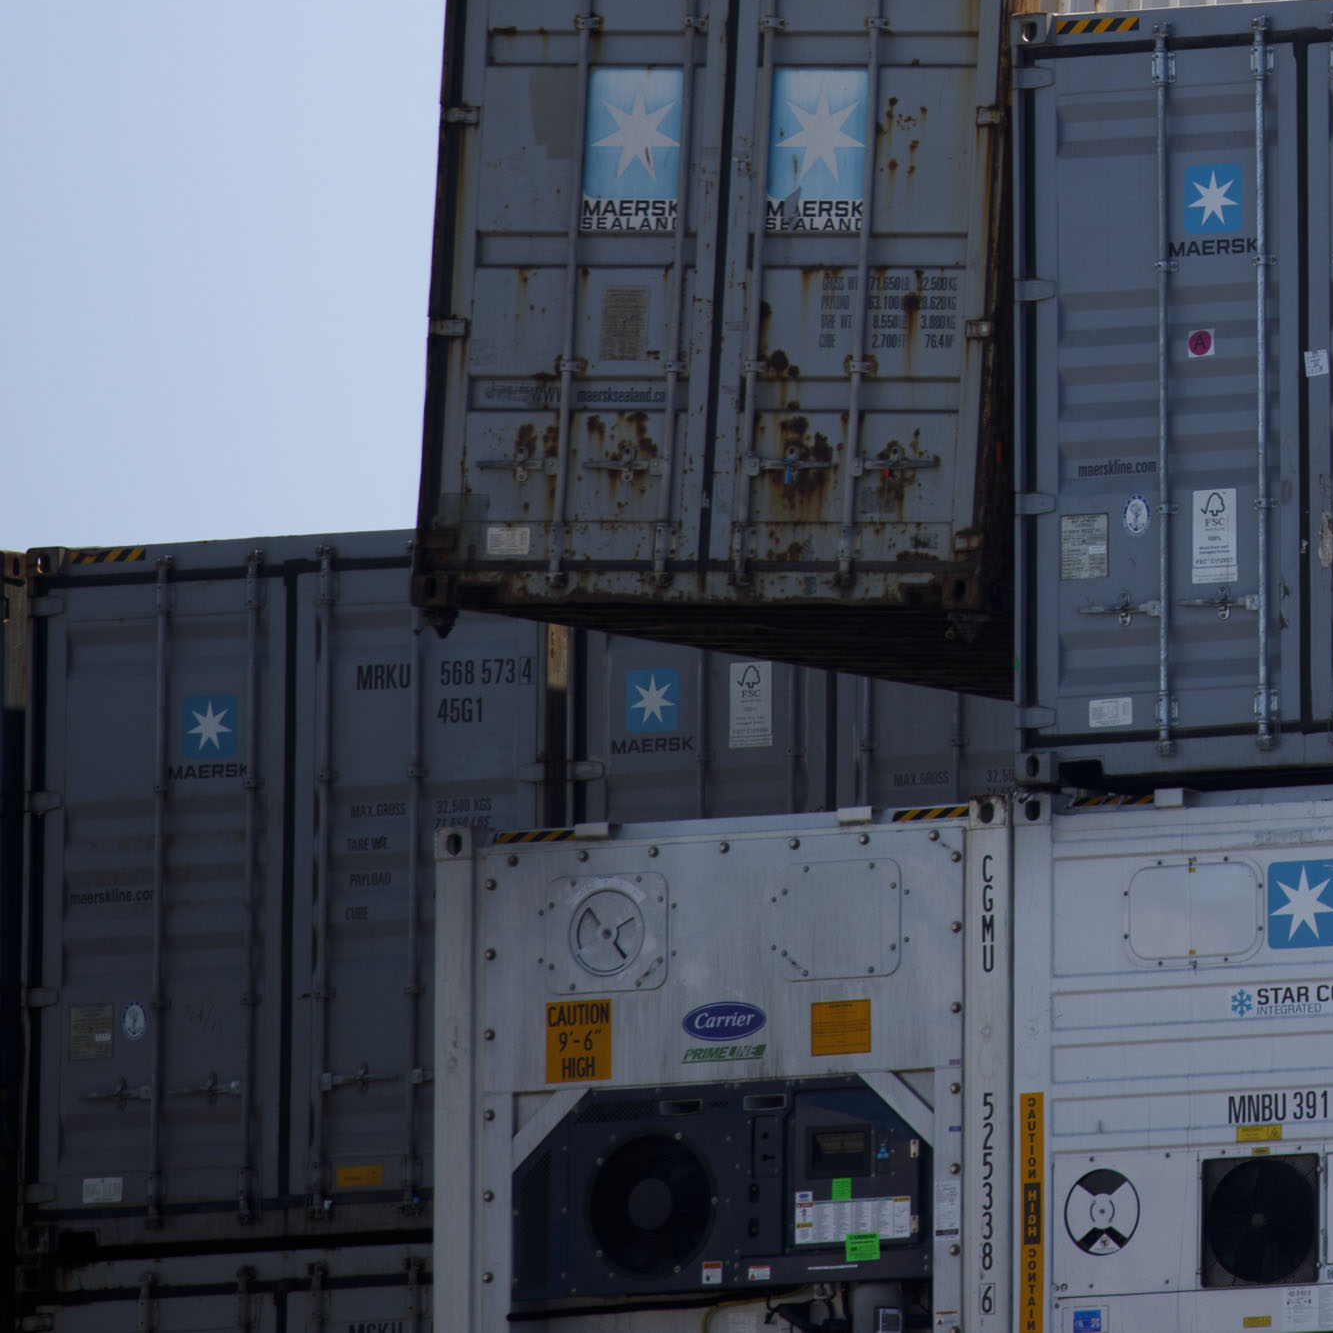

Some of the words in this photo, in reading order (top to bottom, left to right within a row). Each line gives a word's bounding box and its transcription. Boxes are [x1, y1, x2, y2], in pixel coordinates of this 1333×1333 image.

[582, 200, 678, 217] MAERSK
[1167, 237, 1258, 258] MAERSK
[1193, 333, 1207, 350] A
[1078, 458, 1157, 478] maerskline.com
[1204, 517, 1225, 527] FSC
[356, 664, 411, 691] MRKU
[439, 659, 474, 686] 568
[481, 657, 516, 684] 573
[437, 697, 483, 724] 45G1
[611, 735, 695, 755] MAERSK
[167, 763, 249, 781] MAERSK
[474, 797, 493, 812] KGS
[346, 836, 373, 852] TARE
[351, 871, 391, 886] PAYLOAD
[344, 906, 369, 921] CUBE
[982, 855, 994, 972] CGMU
[1257, 986, 1309, 1005] STAR
[548, 1002, 609, 1027] CAUTION
[1257, 1003, 1322, 1016] INTEGRATED
[694, 1011, 756, 1030] Carrier
[562, 1056, 595, 1080] HIGH
[1228, 1093, 1287, 1125] MNBU
[1293, 1090, 1329, 1120] 391
[982, 1092, 993, 1270] 525338
[982, 1286, 992, 1313] 6
